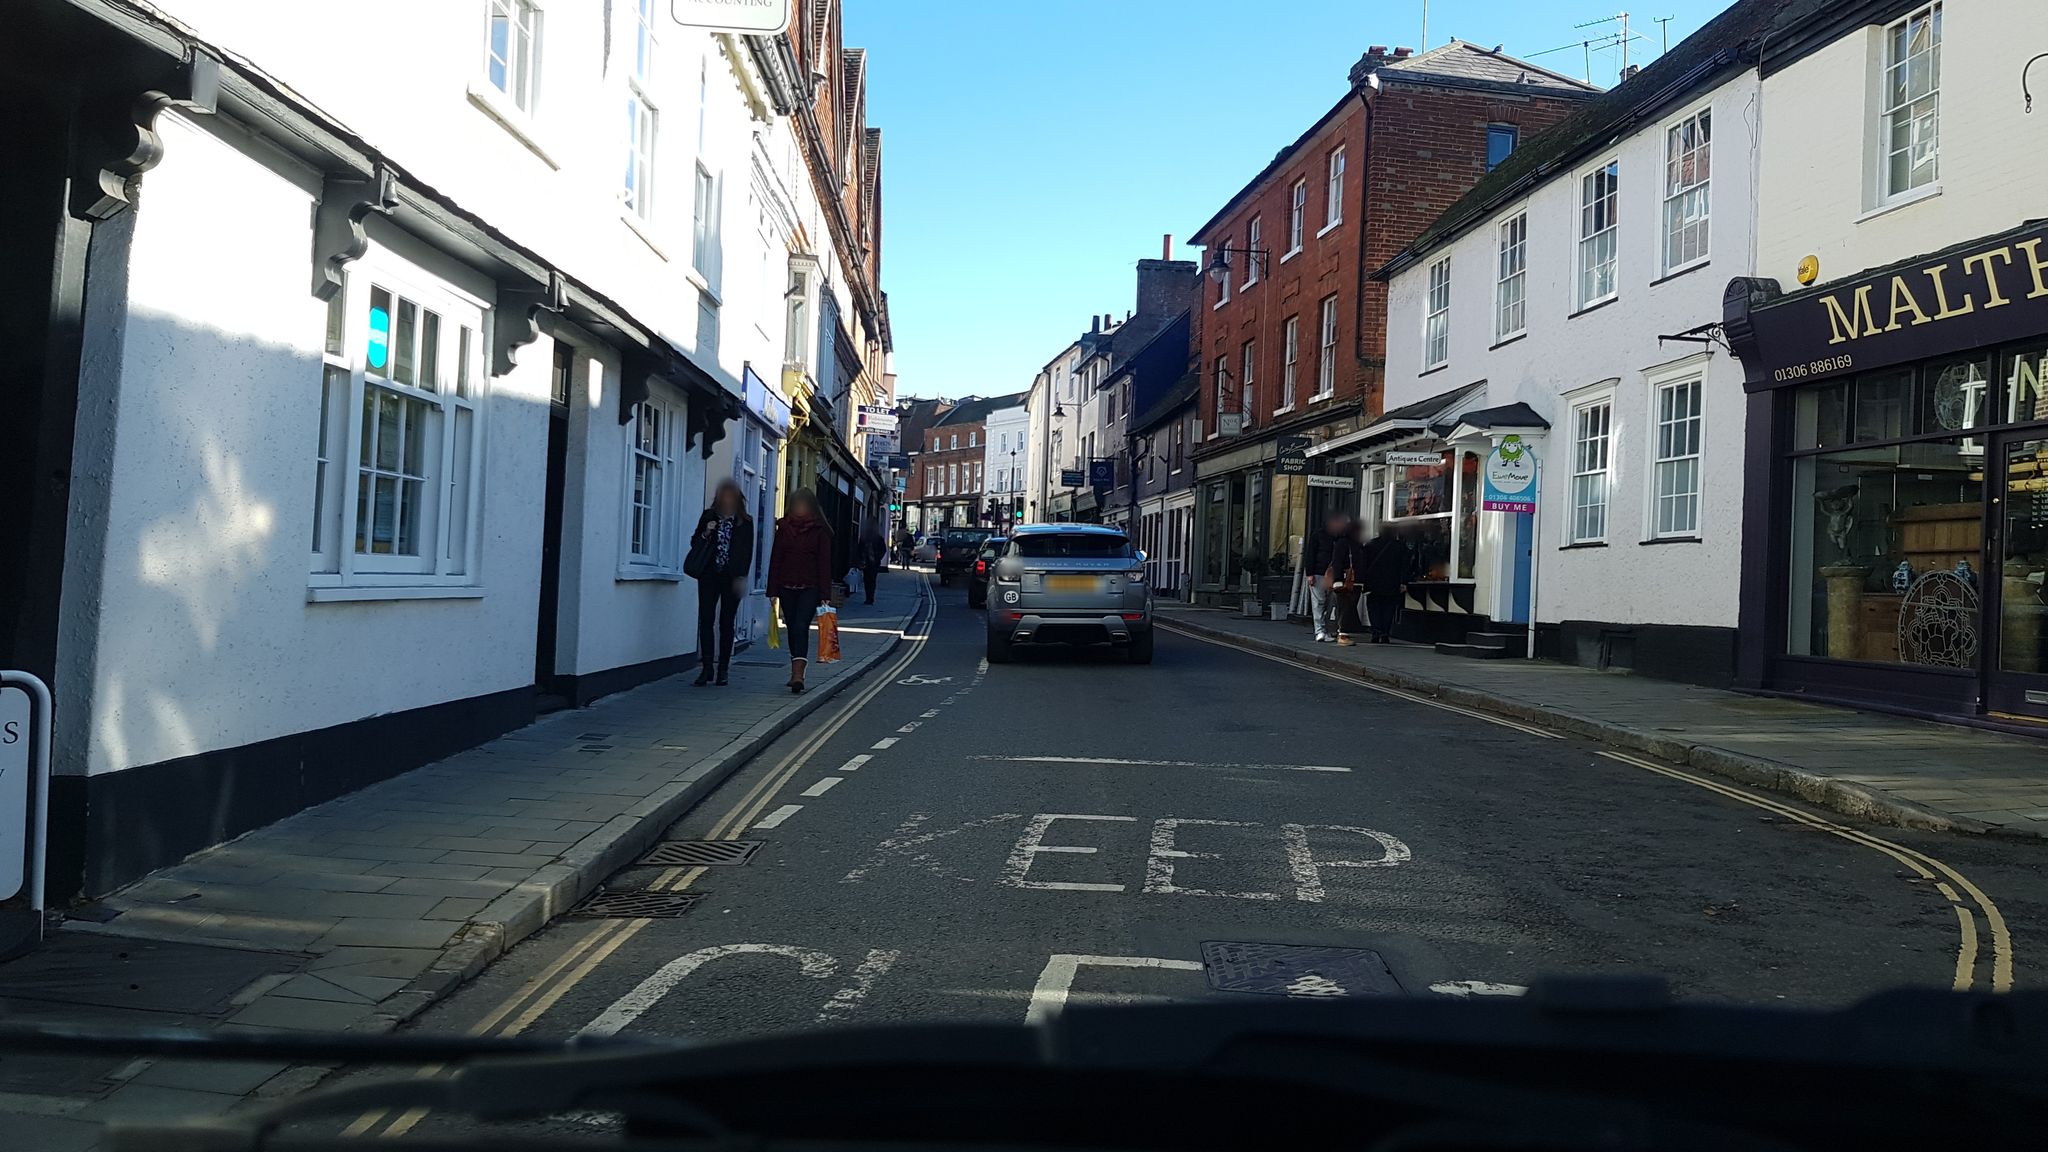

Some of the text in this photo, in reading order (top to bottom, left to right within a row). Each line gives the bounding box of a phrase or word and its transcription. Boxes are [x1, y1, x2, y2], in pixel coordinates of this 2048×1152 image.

[1774, 354, 1852, 382] 01306 886169
[1281, 457, 1307, 465] FABRIC
[1389, 455, 1417, 464] Antiques
[1283, 464, 1303, 472] SHOP
[1310, 477, 1334, 486] Antiques
[1492, 502, 1528, 511] BUY ME
[1005, 592, 1017, 602] GB
[838, 813, 1412, 903] KEEP
